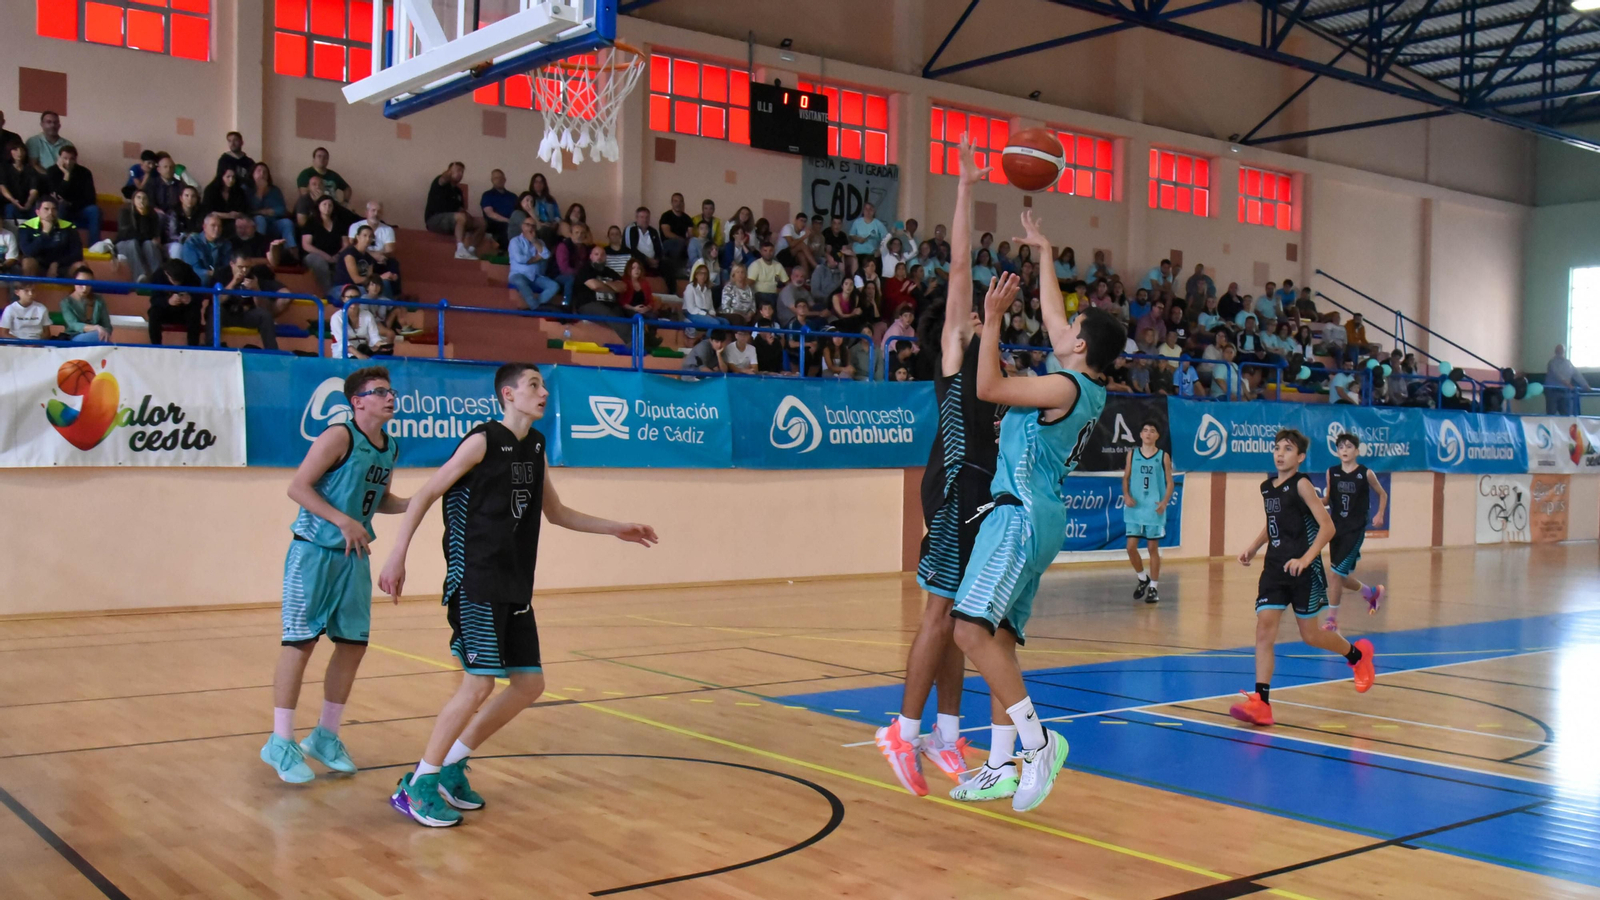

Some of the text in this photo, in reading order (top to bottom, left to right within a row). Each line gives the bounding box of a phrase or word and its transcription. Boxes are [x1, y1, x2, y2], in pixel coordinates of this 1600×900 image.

[783, 92, 788, 104] 1
[800, 95, 809, 108] 0
[799, 109, 829, 123] VISITANTE
[840, 161, 850, 172] ES
[854, 163, 864, 174] TU
[635, 399, 719, 420] Diputación
[824, 405, 915, 424] baloncesto
[129, 422, 216, 452] cesto
[637, 423, 704, 444] de Cádiz
[1231, 438, 1275, 453] andaluc
[1359, 442, 1410, 458] OSTENIBLE
[1143, 476, 1150, 490] 9
[1479, 474, 1510, 497] Casa
[362, 489, 377, 517] 8
[1341, 494, 1350, 511] 7
